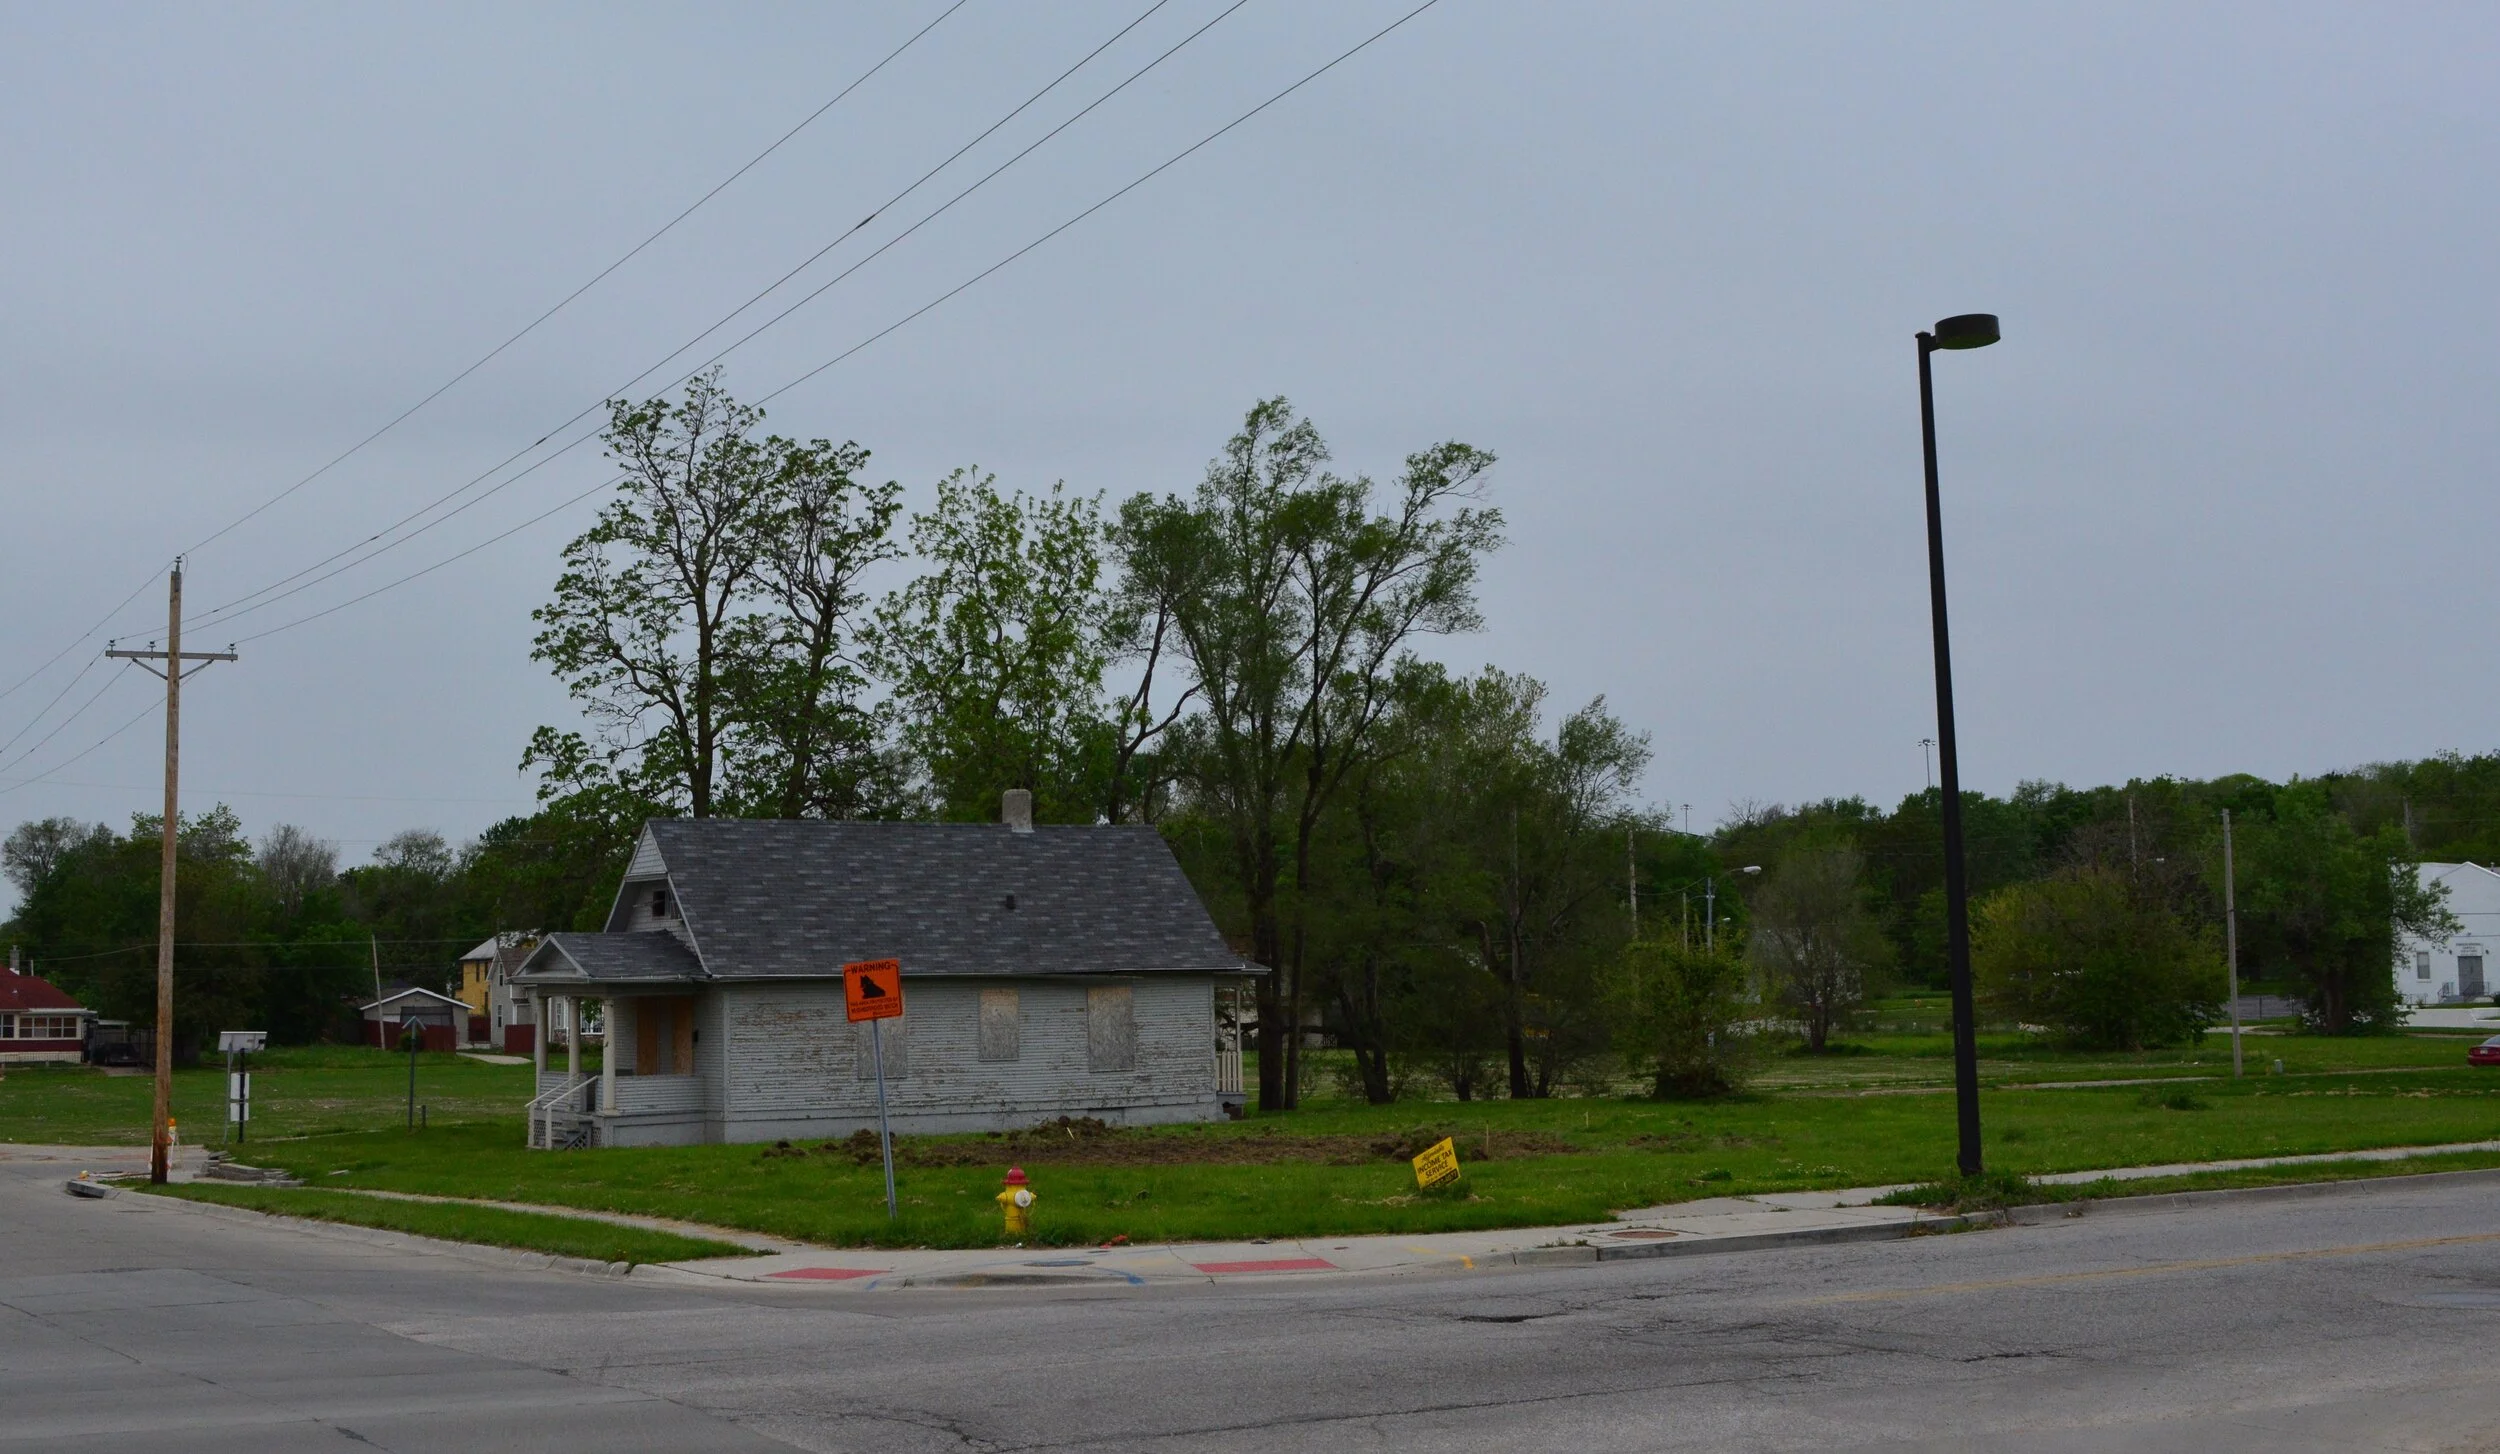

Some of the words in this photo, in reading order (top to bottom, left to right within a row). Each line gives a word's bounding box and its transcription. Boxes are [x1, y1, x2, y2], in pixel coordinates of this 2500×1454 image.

[851, 961, 890, 974] WARNING
[1417, 1157, 1442, 1175] INCOME
[1442, 1150, 1453, 1160] TAX
[1425, 1160, 1449, 1178] SERVICE
